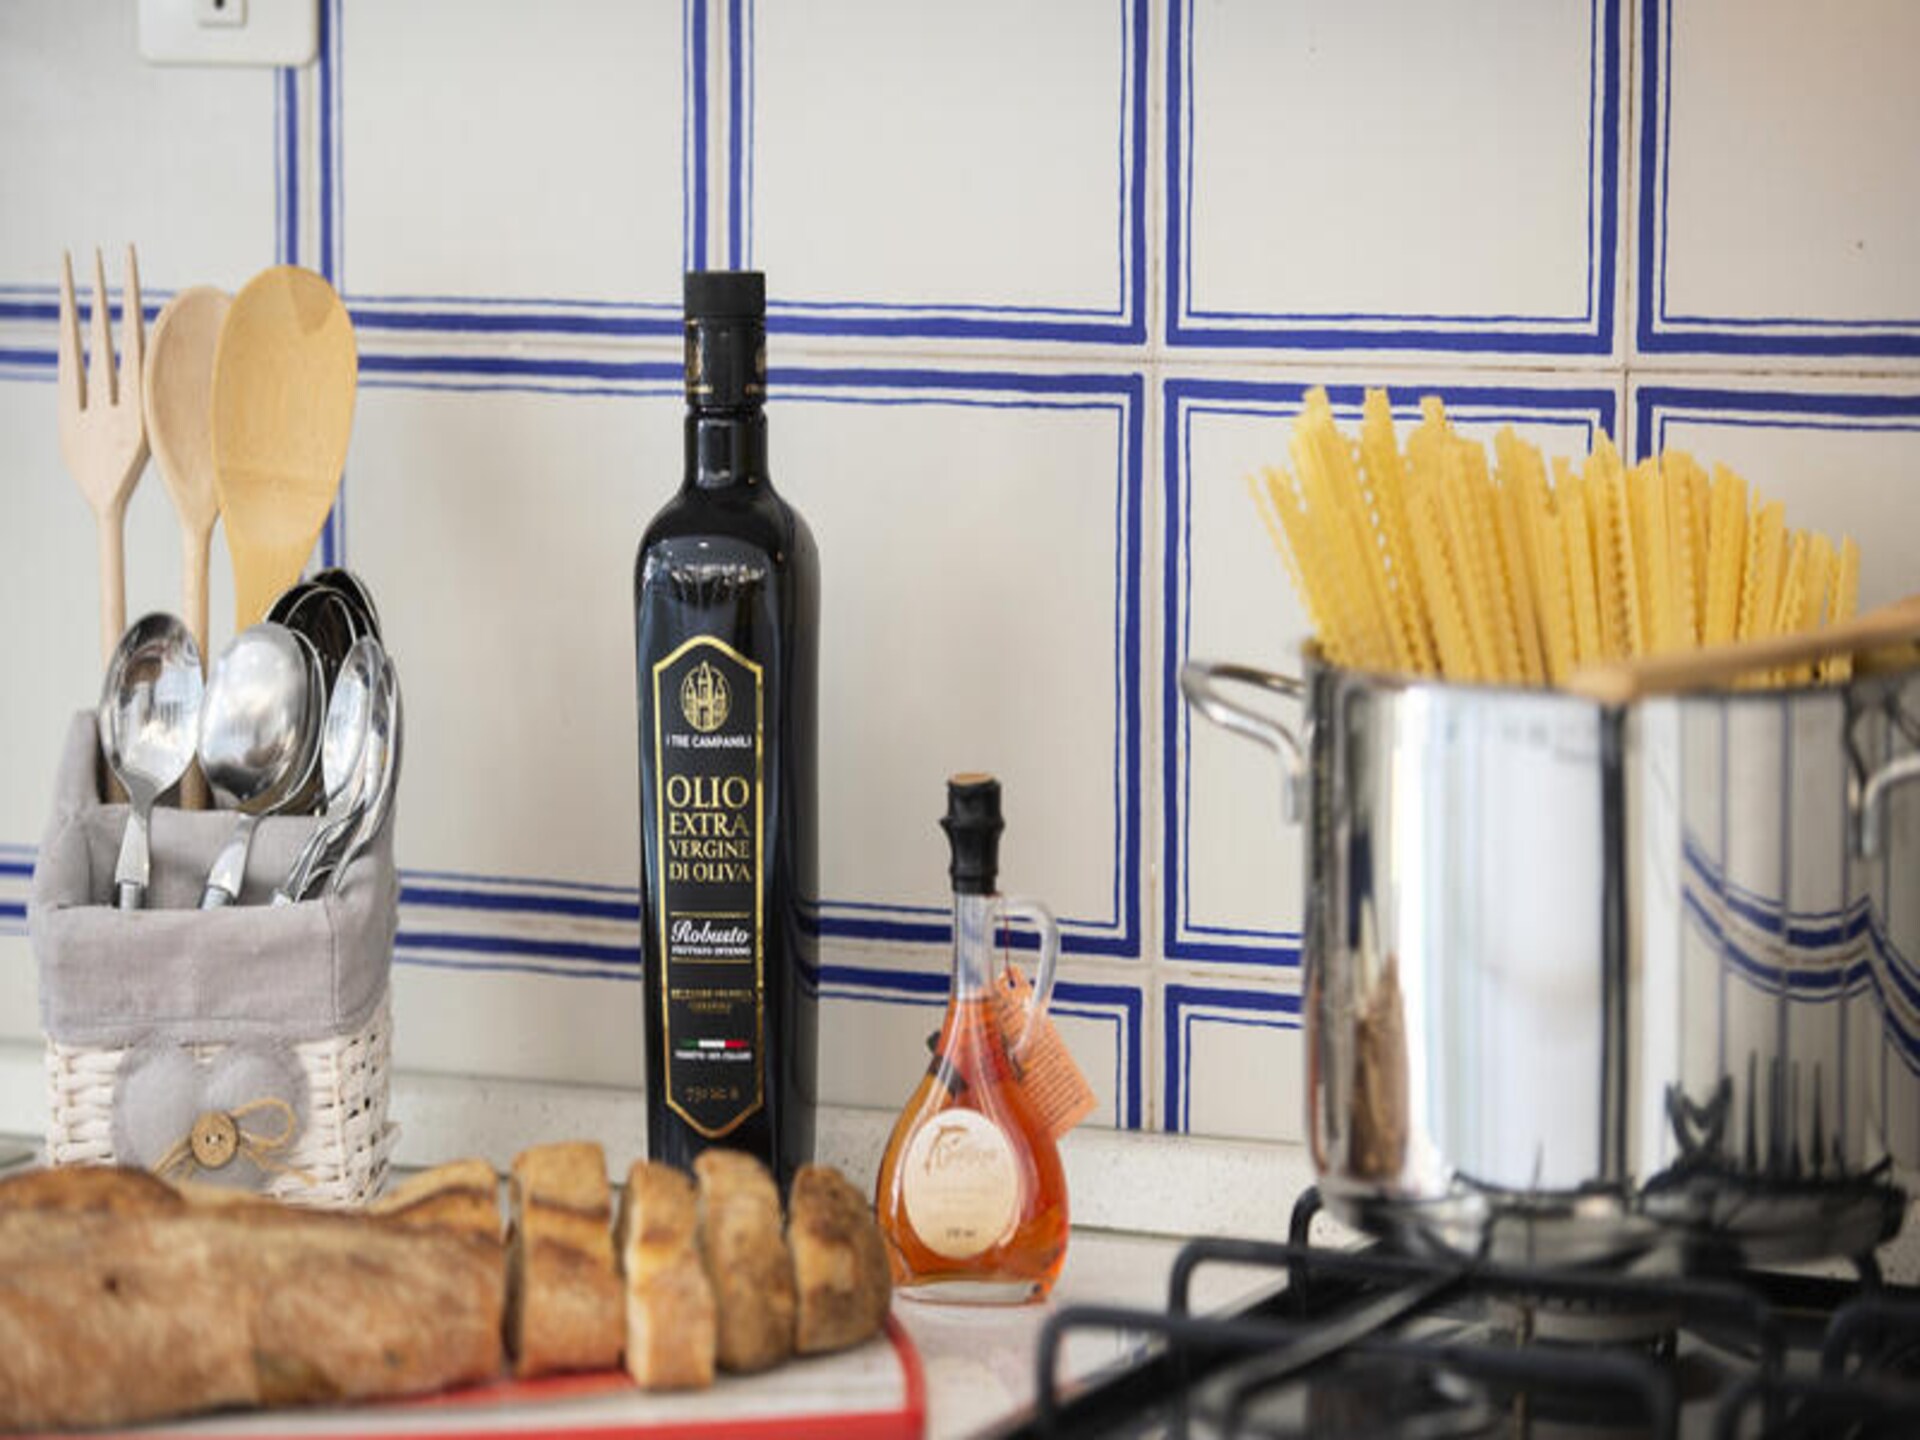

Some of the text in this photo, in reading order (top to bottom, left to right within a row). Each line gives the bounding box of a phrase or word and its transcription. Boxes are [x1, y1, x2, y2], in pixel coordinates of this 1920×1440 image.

[672, 734, 690, 747] TRE
[667, 774, 749, 809] OLIO
[669, 812, 749, 837] EXTRA
[669, 839, 749, 858] VERGINE
[669, 860, 750, 882] DI OLIVA
[671, 920, 748, 943] Robusto
